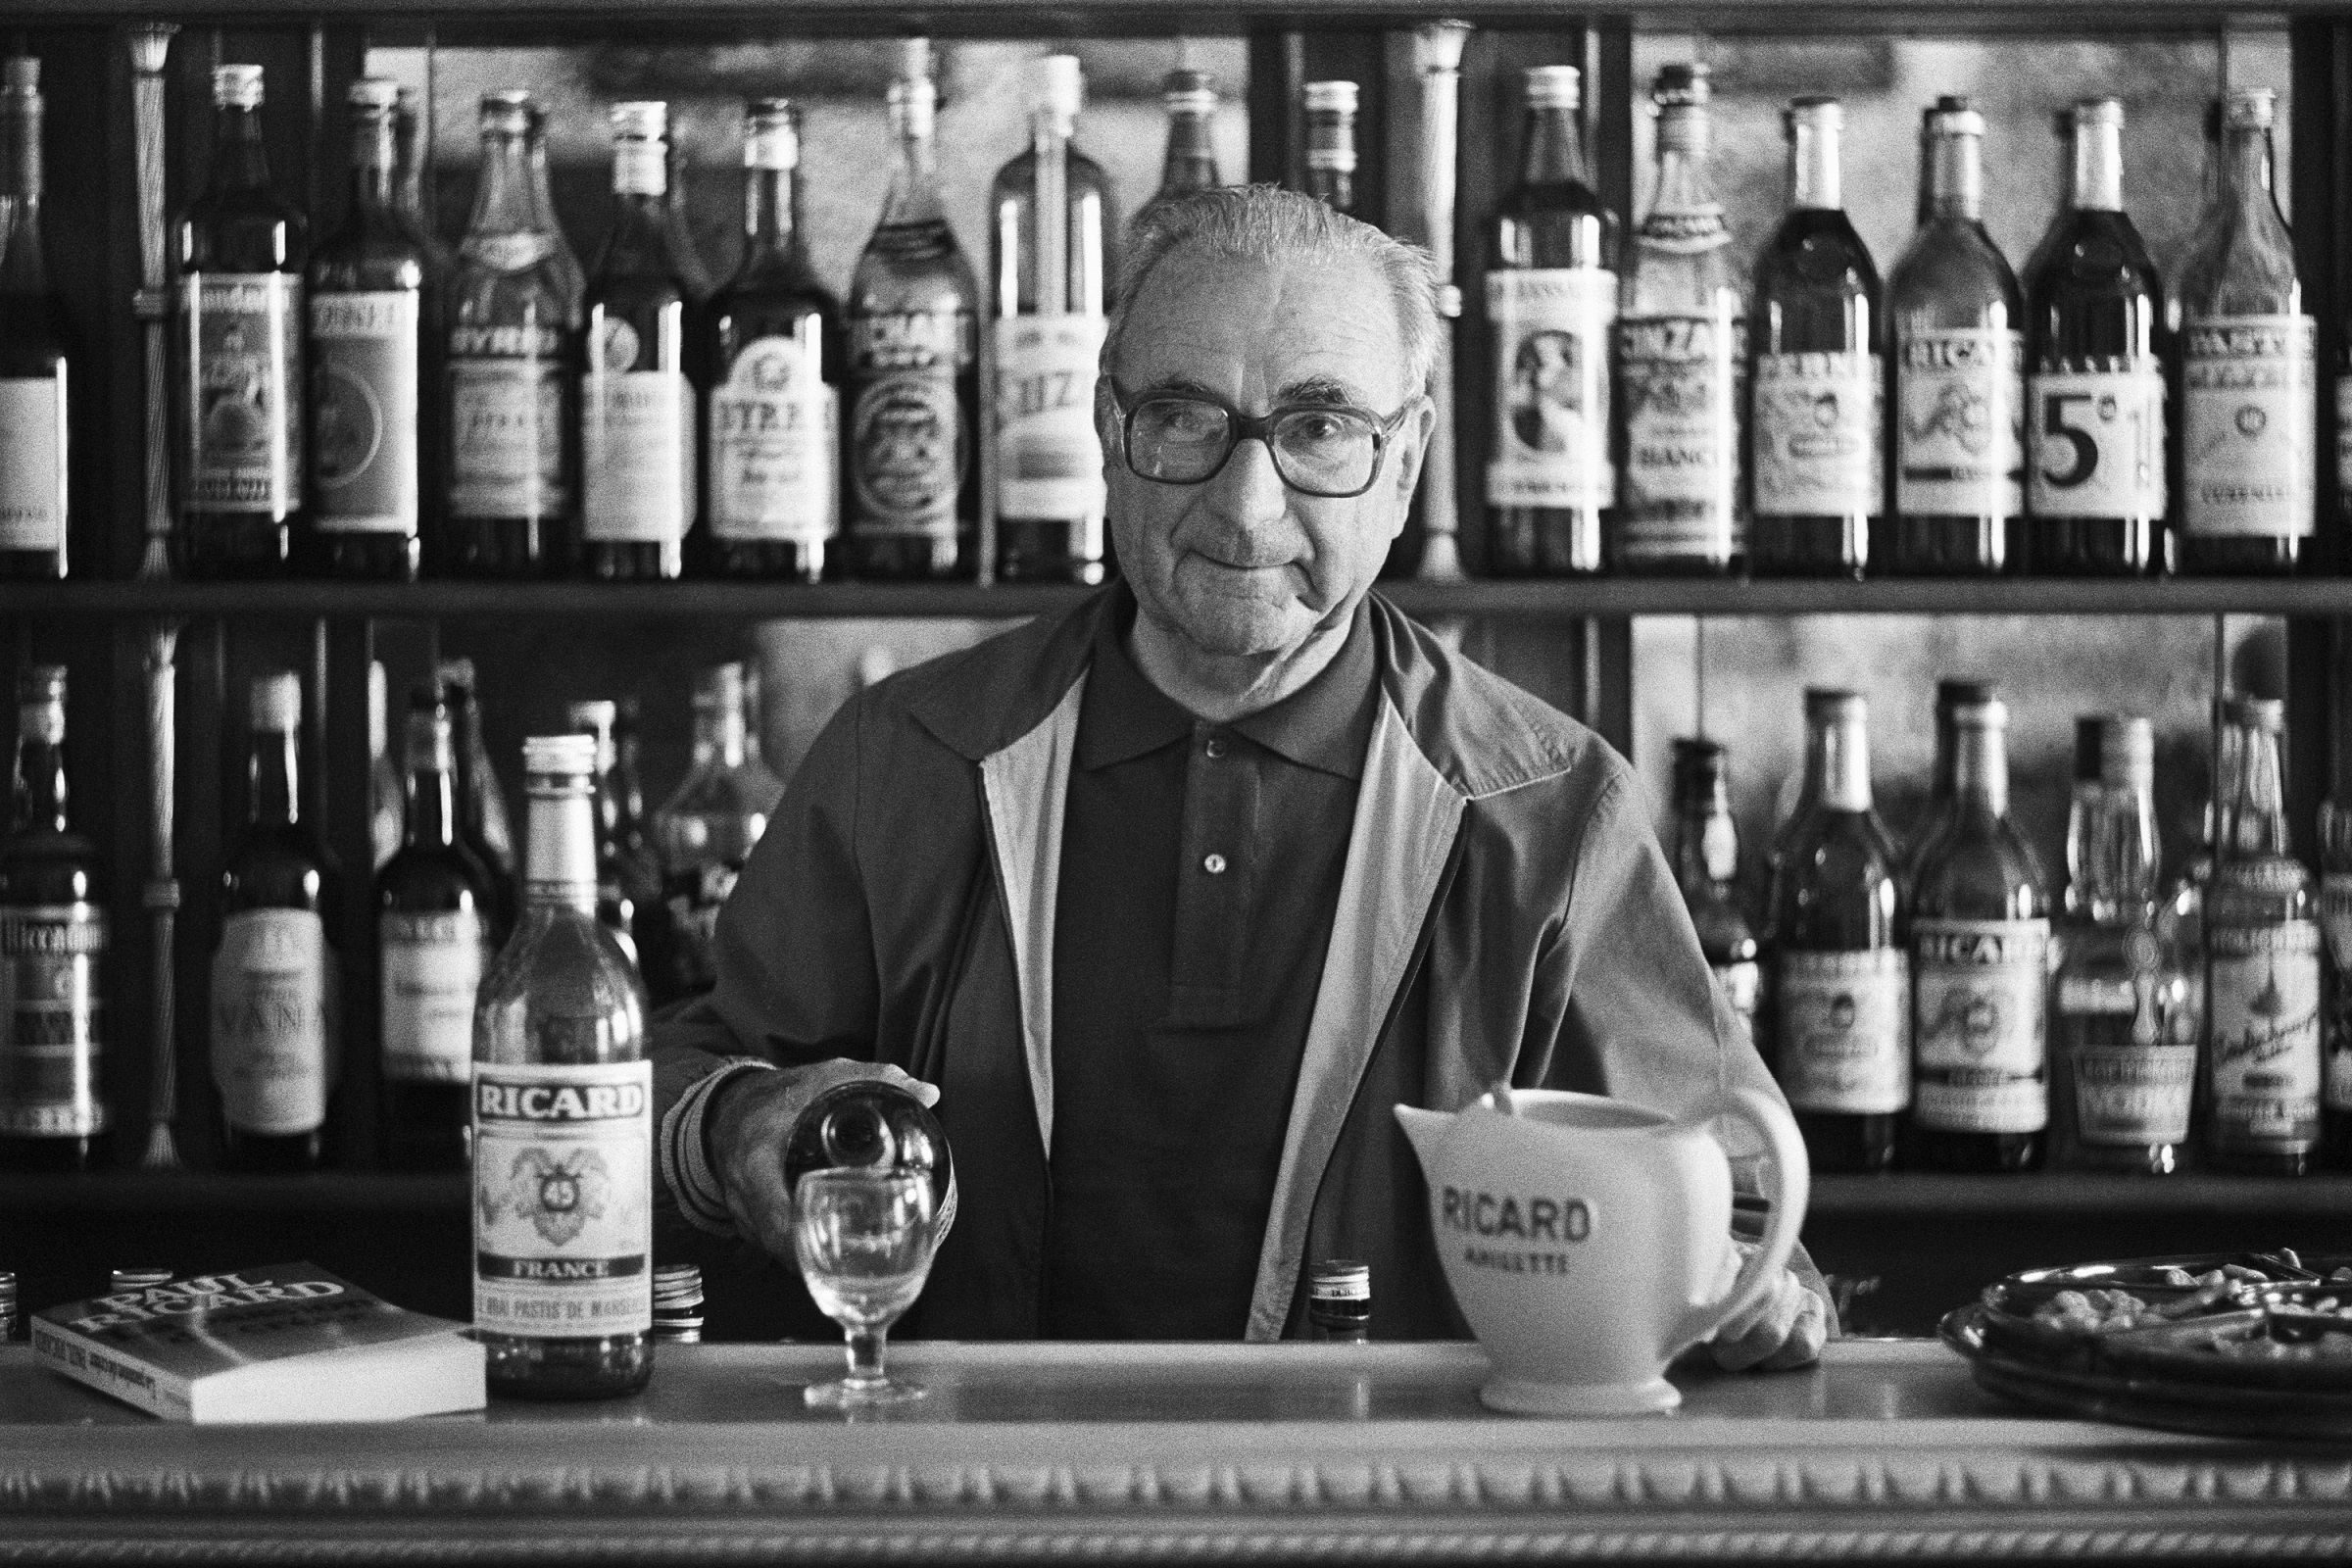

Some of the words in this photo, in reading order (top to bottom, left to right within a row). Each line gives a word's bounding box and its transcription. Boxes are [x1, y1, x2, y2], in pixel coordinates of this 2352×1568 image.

[480, 1085, 643, 1119] RICARD
[544, 1181, 574, 1205] 45
[1443, 1185, 1592, 1244] RICARD
[513, 1260, 610, 1278] FRANCE
[71, 1281, 345, 1332] RICARD
[93, 1273, 273, 1310] PAUL
[514, 1299, 561, 1319] PASTIS
[566, 1300, 584, 1320] DE
